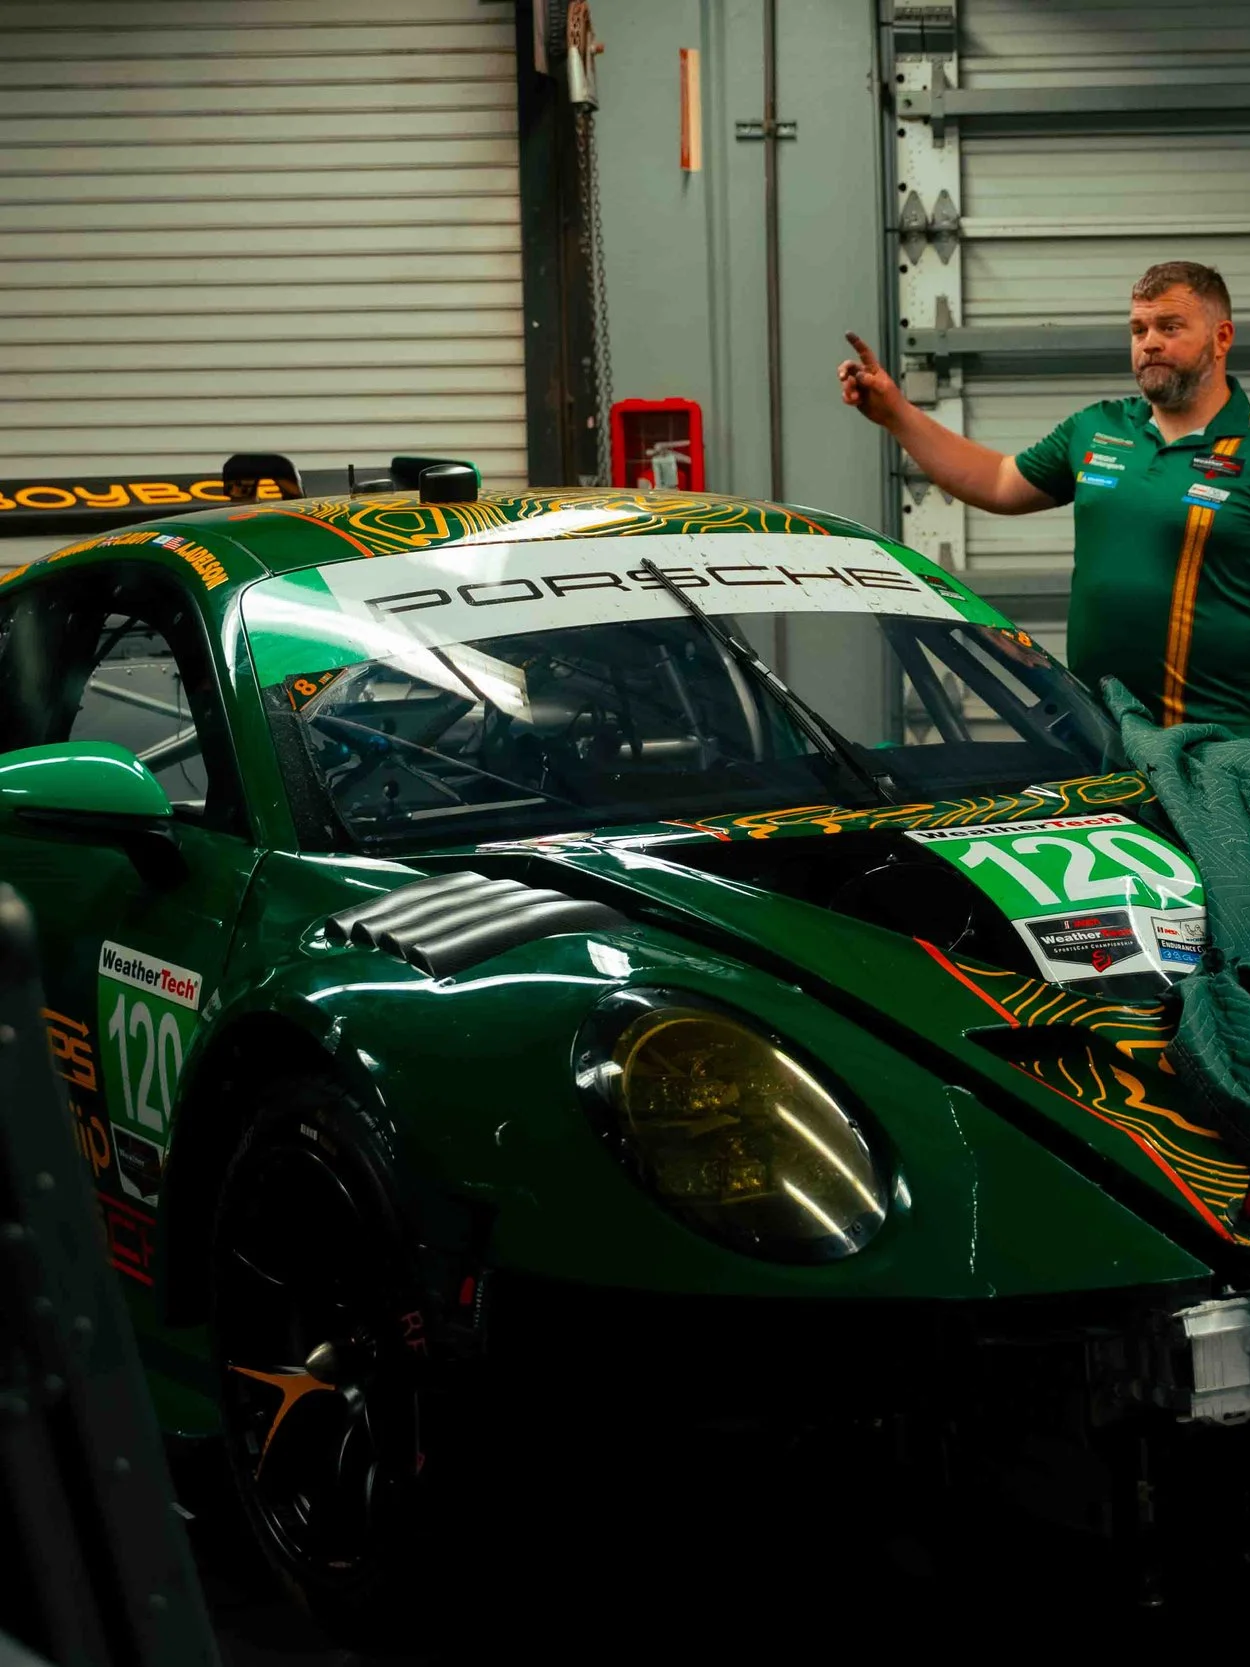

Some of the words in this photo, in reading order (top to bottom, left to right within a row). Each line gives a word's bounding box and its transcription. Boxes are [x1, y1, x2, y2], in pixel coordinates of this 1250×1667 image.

[364, 565, 922, 623] PORSCHE
[294, 678, 317, 696] 8
[917, 815, 1123, 840] WeatherTech
[957, 830, 1196, 906] 120
[102, 948, 198, 1000] WeatherTech
[108, 993, 184, 1134] 120
